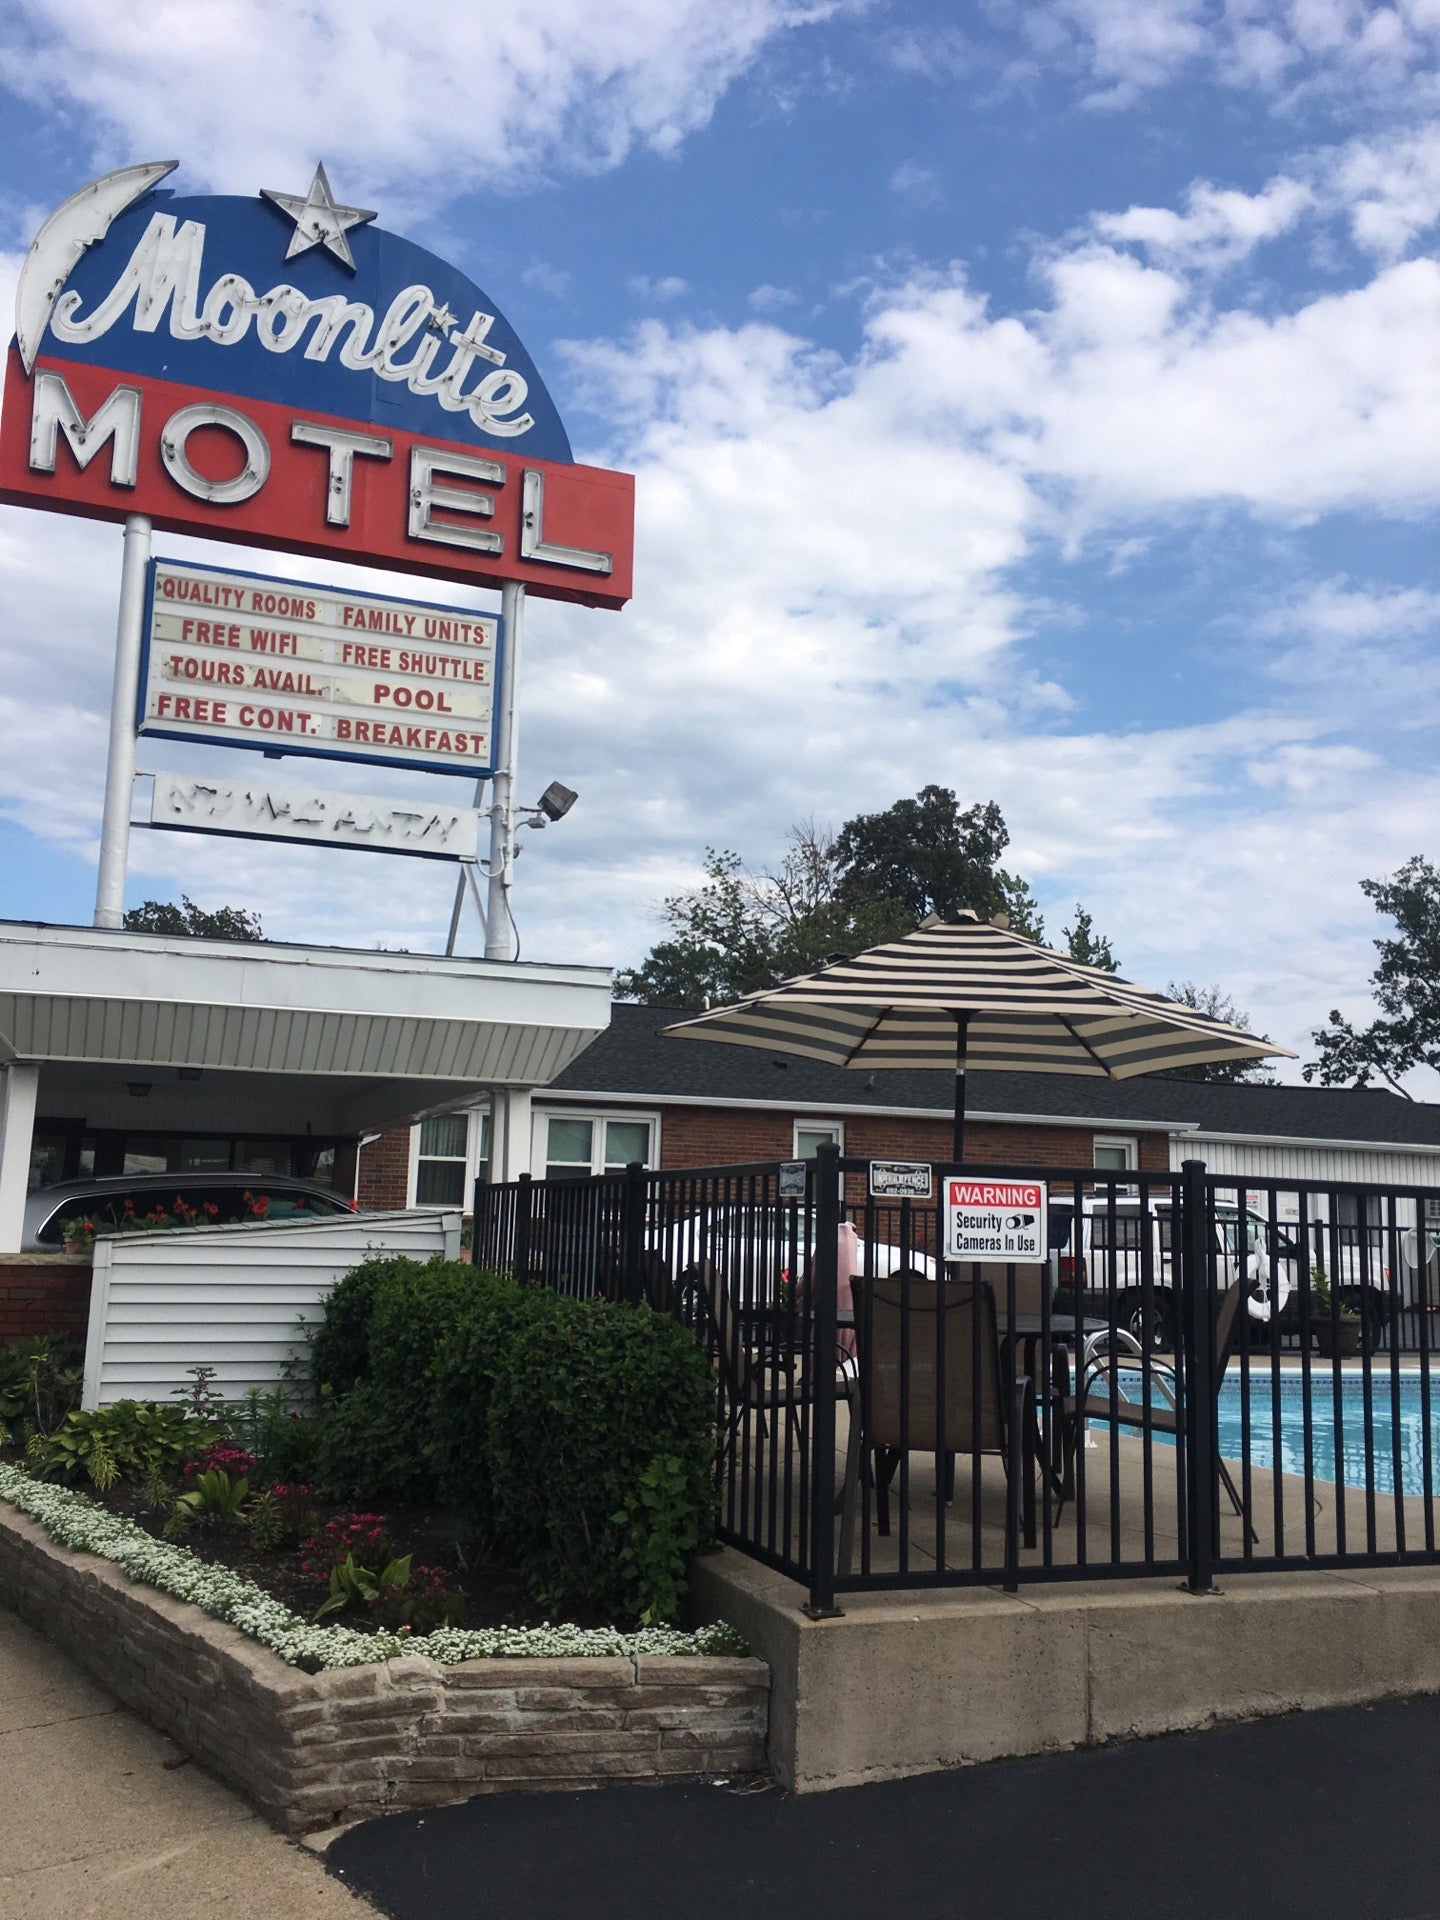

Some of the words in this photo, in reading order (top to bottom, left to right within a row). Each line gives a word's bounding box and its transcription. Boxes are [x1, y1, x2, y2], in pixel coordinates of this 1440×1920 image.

[50, 212, 537, 437] Moonlite
[29, 368, 613, 575] MOTEL
[163, 578, 245, 608] QUALITY
[252, 592, 316, 619] ROOMS
[182, 620, 240, 648] FREE
[250, 630, 297, 655] WIFI
[343, 606, 416, 635] FAMILY
[424, 618, 484, 645] UNITS
[170, 656, 244, 685] TOURS
[253, 669, 323, 696] AVAIL.
[343, 644, 391, 669] FREE
[399, 652, 484, 681] SHUTTLE
[374, 684, 452, 712] POOL
[158, 695, 226, 723] FREE
[239, 706, 316, 734] CONT.
[337, 719, 484, 754] BREAKFAST
[955, 1186, 1036, 1205] WARNING
[957, 1211, 1002, 1232] Security
[957, 1233, 1001, 1250] Cameras
[1005, 1234, 1014, 1251] In
[1018, 1235, 1035, 1251] Use
